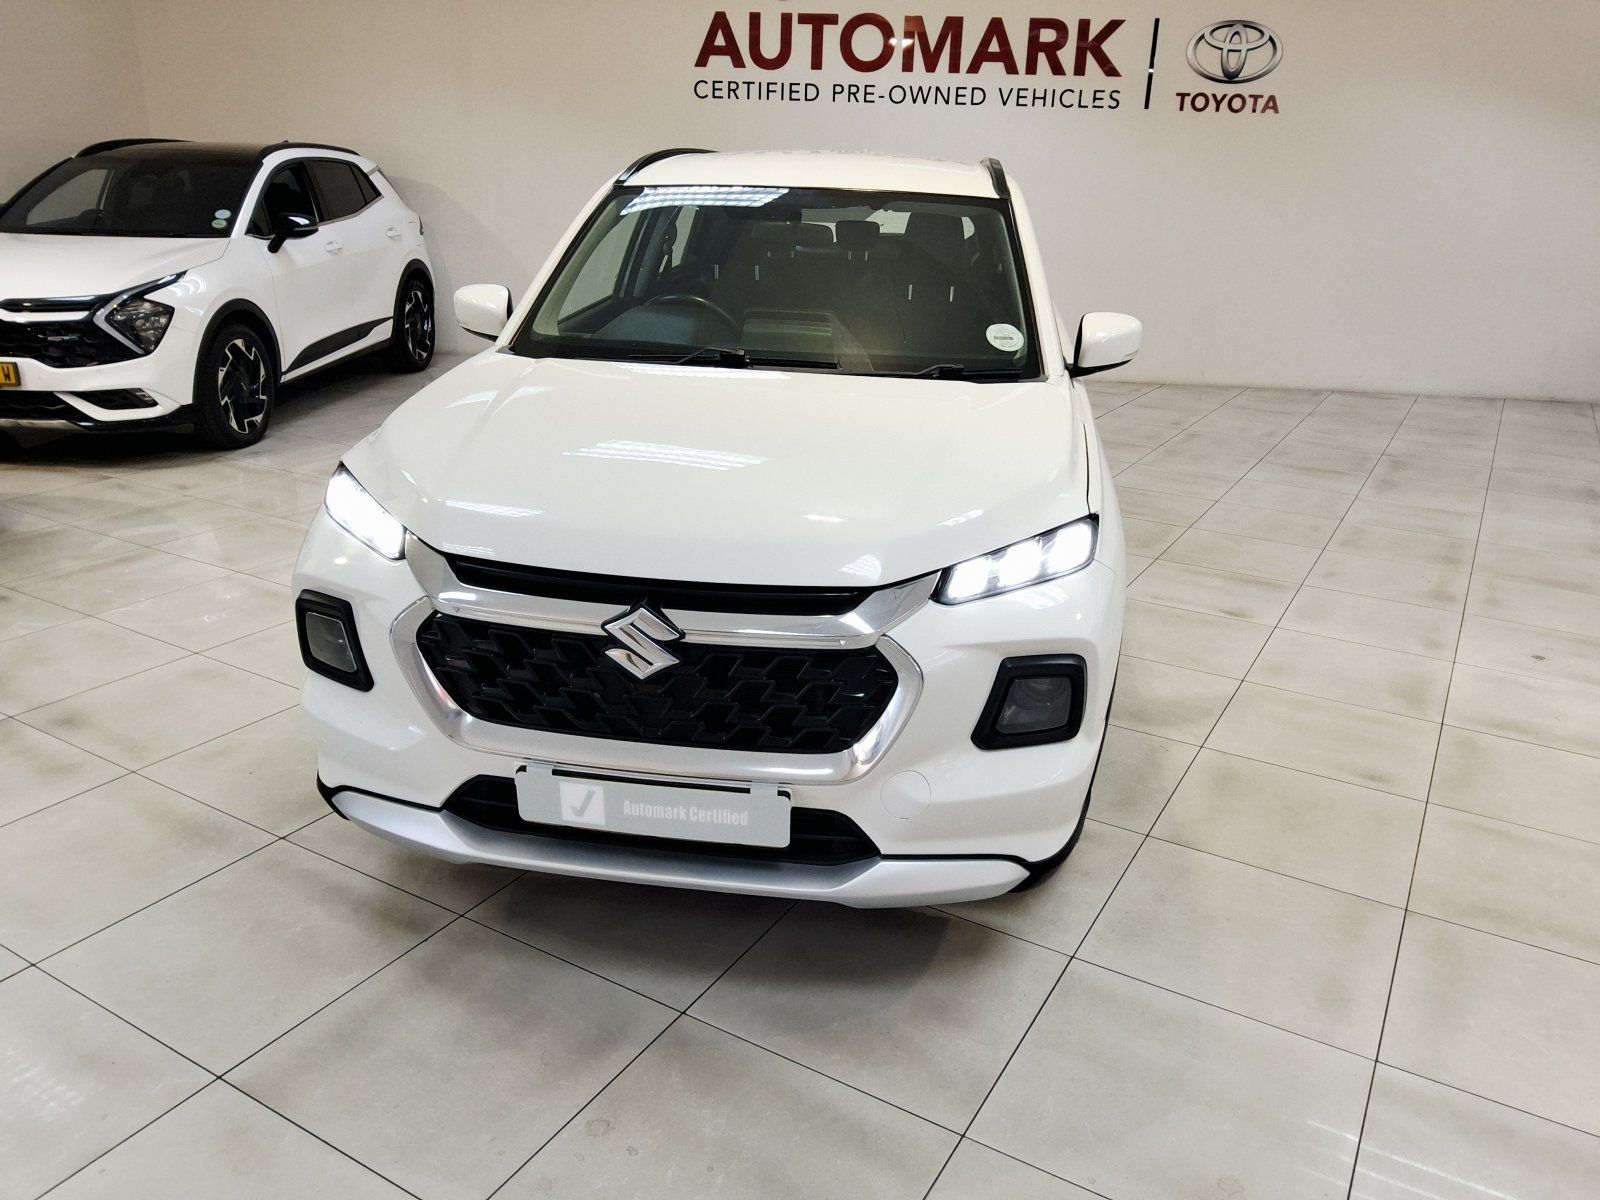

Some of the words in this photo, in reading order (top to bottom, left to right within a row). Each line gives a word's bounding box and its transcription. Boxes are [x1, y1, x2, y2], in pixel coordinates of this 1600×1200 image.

[694, 10, 1126, 78] AUTOMARK
[693, 79, 820, 101] CERTIFIED
[832, 83, 987, 106] PRE-OWNED
[998, 87, 1121, 110] VEHICLES
[1175, 92, 1280, 114] TOYOTA
[623, 800, 687, 821] Automark
[689, 806, 749, 826] Certified
